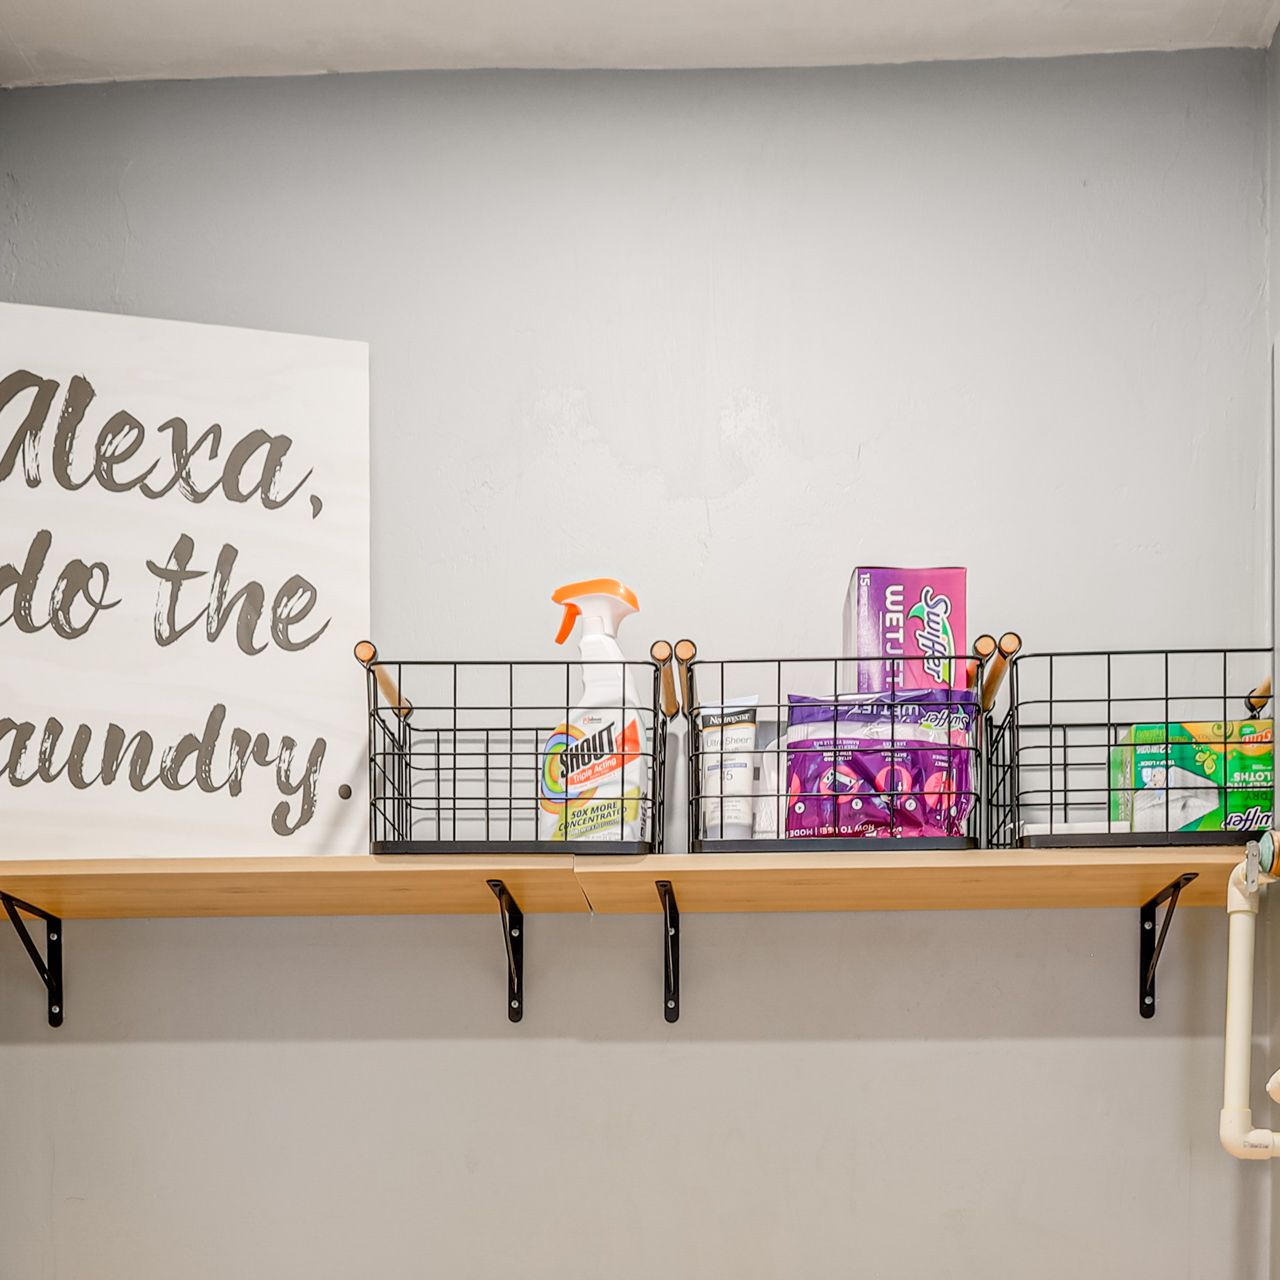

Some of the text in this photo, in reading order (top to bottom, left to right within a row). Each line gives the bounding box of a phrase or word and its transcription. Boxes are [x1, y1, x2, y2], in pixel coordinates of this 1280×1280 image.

[147, 533, 333, 656] the
[860, 573, 871, 586] 15
[885, 584, 904, 689] WETJET
[916, 586, 951, 683] Swiffer
[560, 721, 615, 779] SHOUT
[572, 757, 617, 784] Triple Acting
[590, 801, 617, 816] MORE
[841, 825, 853, 834] TO
